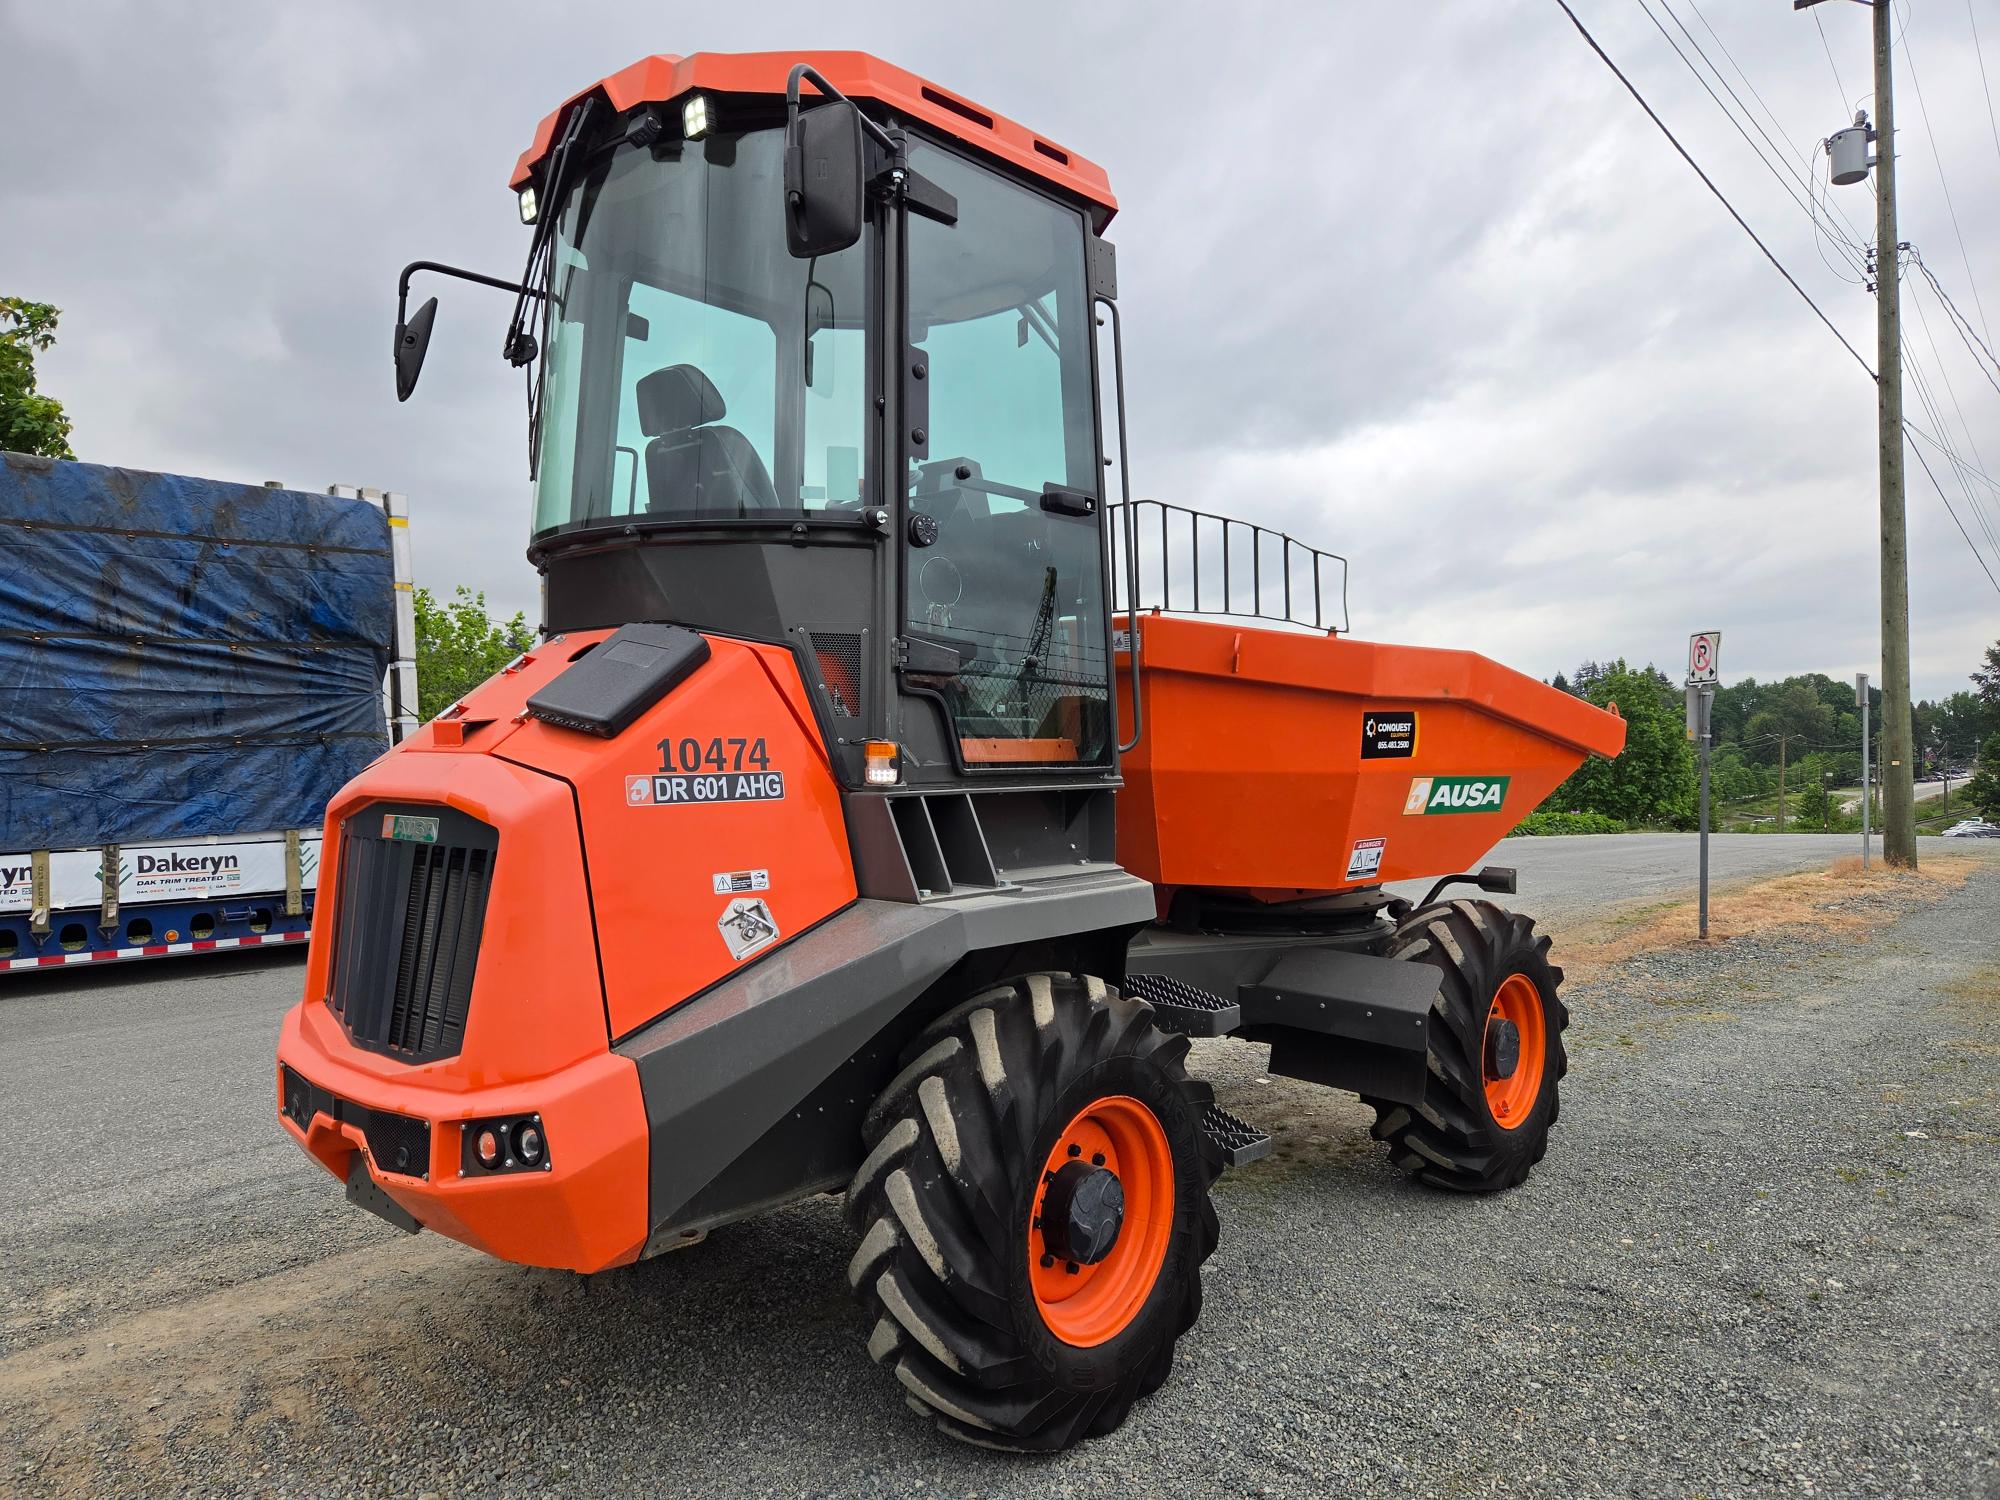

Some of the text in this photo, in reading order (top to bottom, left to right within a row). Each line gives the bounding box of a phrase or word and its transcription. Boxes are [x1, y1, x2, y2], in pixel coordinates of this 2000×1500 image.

[1377, 722, 1412, 732] CONQUEST
[656, 737, 770, 773] 10474
[655, 774, 782, 801] DR 601 AHG
[1428, 782, 1501, 808] AUSA
[137, 852, 239, 875] Dakeryn
